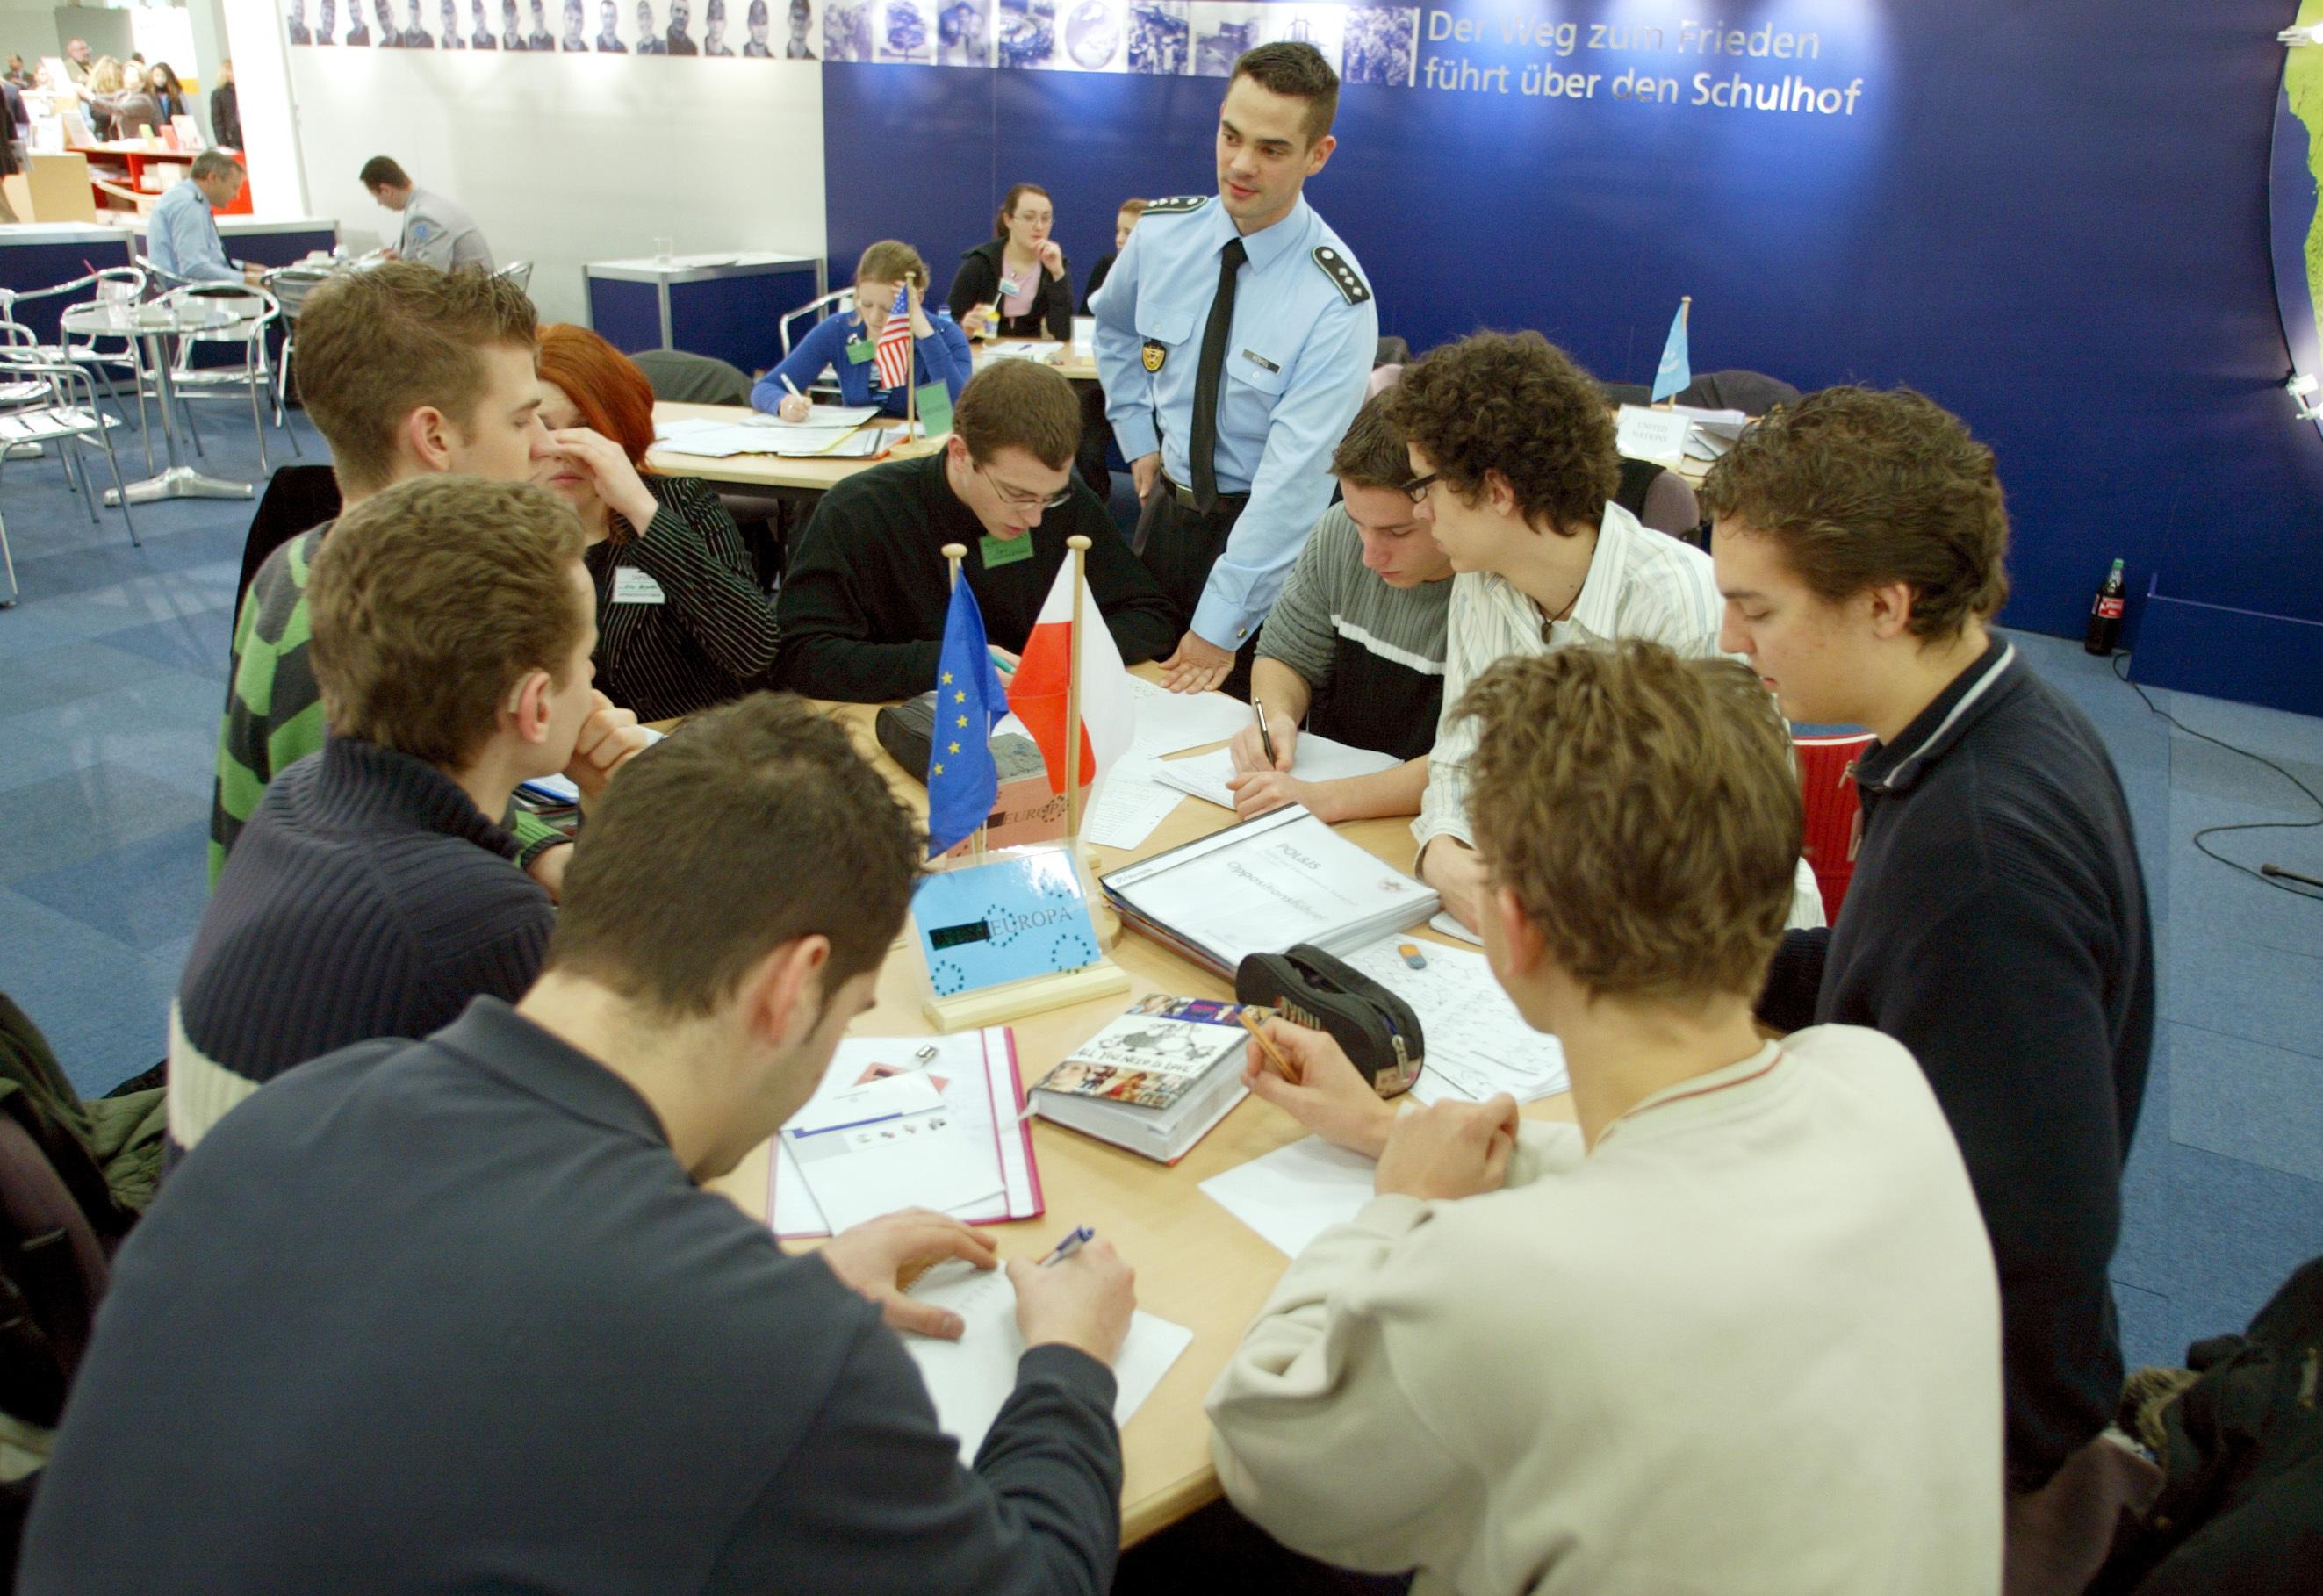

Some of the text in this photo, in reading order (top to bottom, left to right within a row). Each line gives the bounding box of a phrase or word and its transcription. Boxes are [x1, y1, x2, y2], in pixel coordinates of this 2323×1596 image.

[1428, 10, 1820, 60] Der Weg zum Frieden
[1423, 56, 1864, 115] führt über den Schulhof
[1004, 800, 1068, 826] EUROPA
[989, 906, 1073, 936] EUROPA
[1163, 1060, 1193, 1072] LOVE
